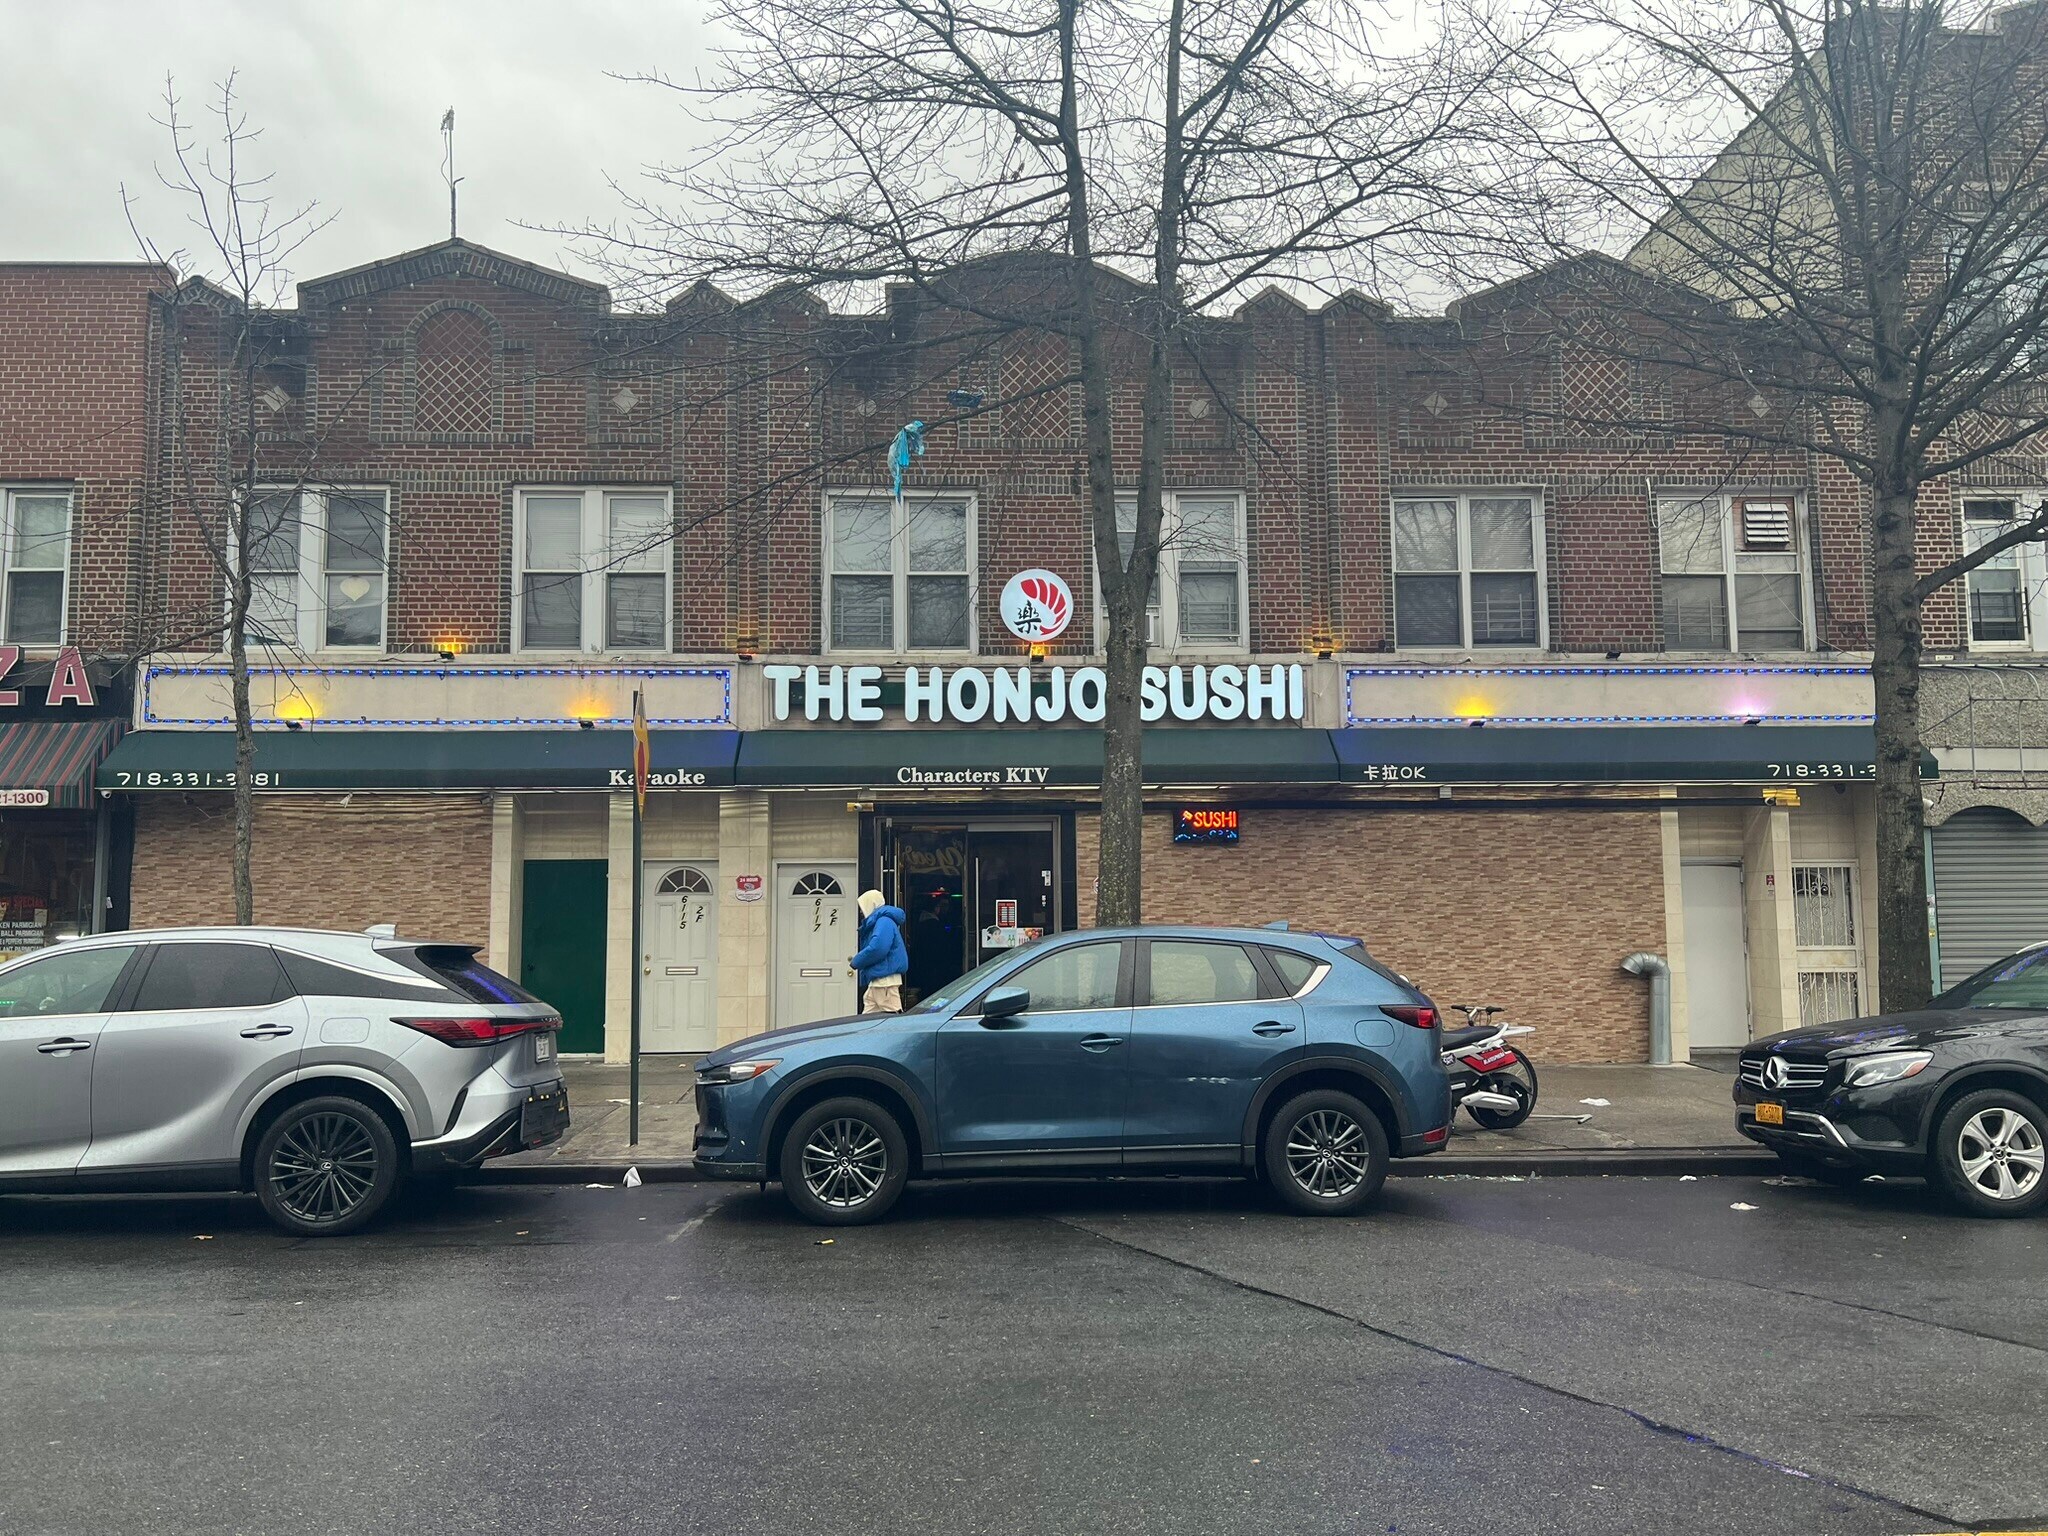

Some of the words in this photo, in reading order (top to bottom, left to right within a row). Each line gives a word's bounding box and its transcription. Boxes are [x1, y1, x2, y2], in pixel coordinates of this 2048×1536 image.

[763, 664, 885, 723] THE
[904, 664, 1108, 724] HONJO
[1139, 663, 1304, 722] SUSHI
[116, 772, 280, 786] 718-331-381
[897, 767, 1001, 784] Characters
[1006, 767, 1050, 783] KTV
[1363, 764, 1426, 781] 卡拉OK
[0, 792, 44, 804] 1-1300
[1192, 810, 1238, 828] SUSHI
[679, 894, 689, 930] 6115
[812, 897, 822, 933] 6117
